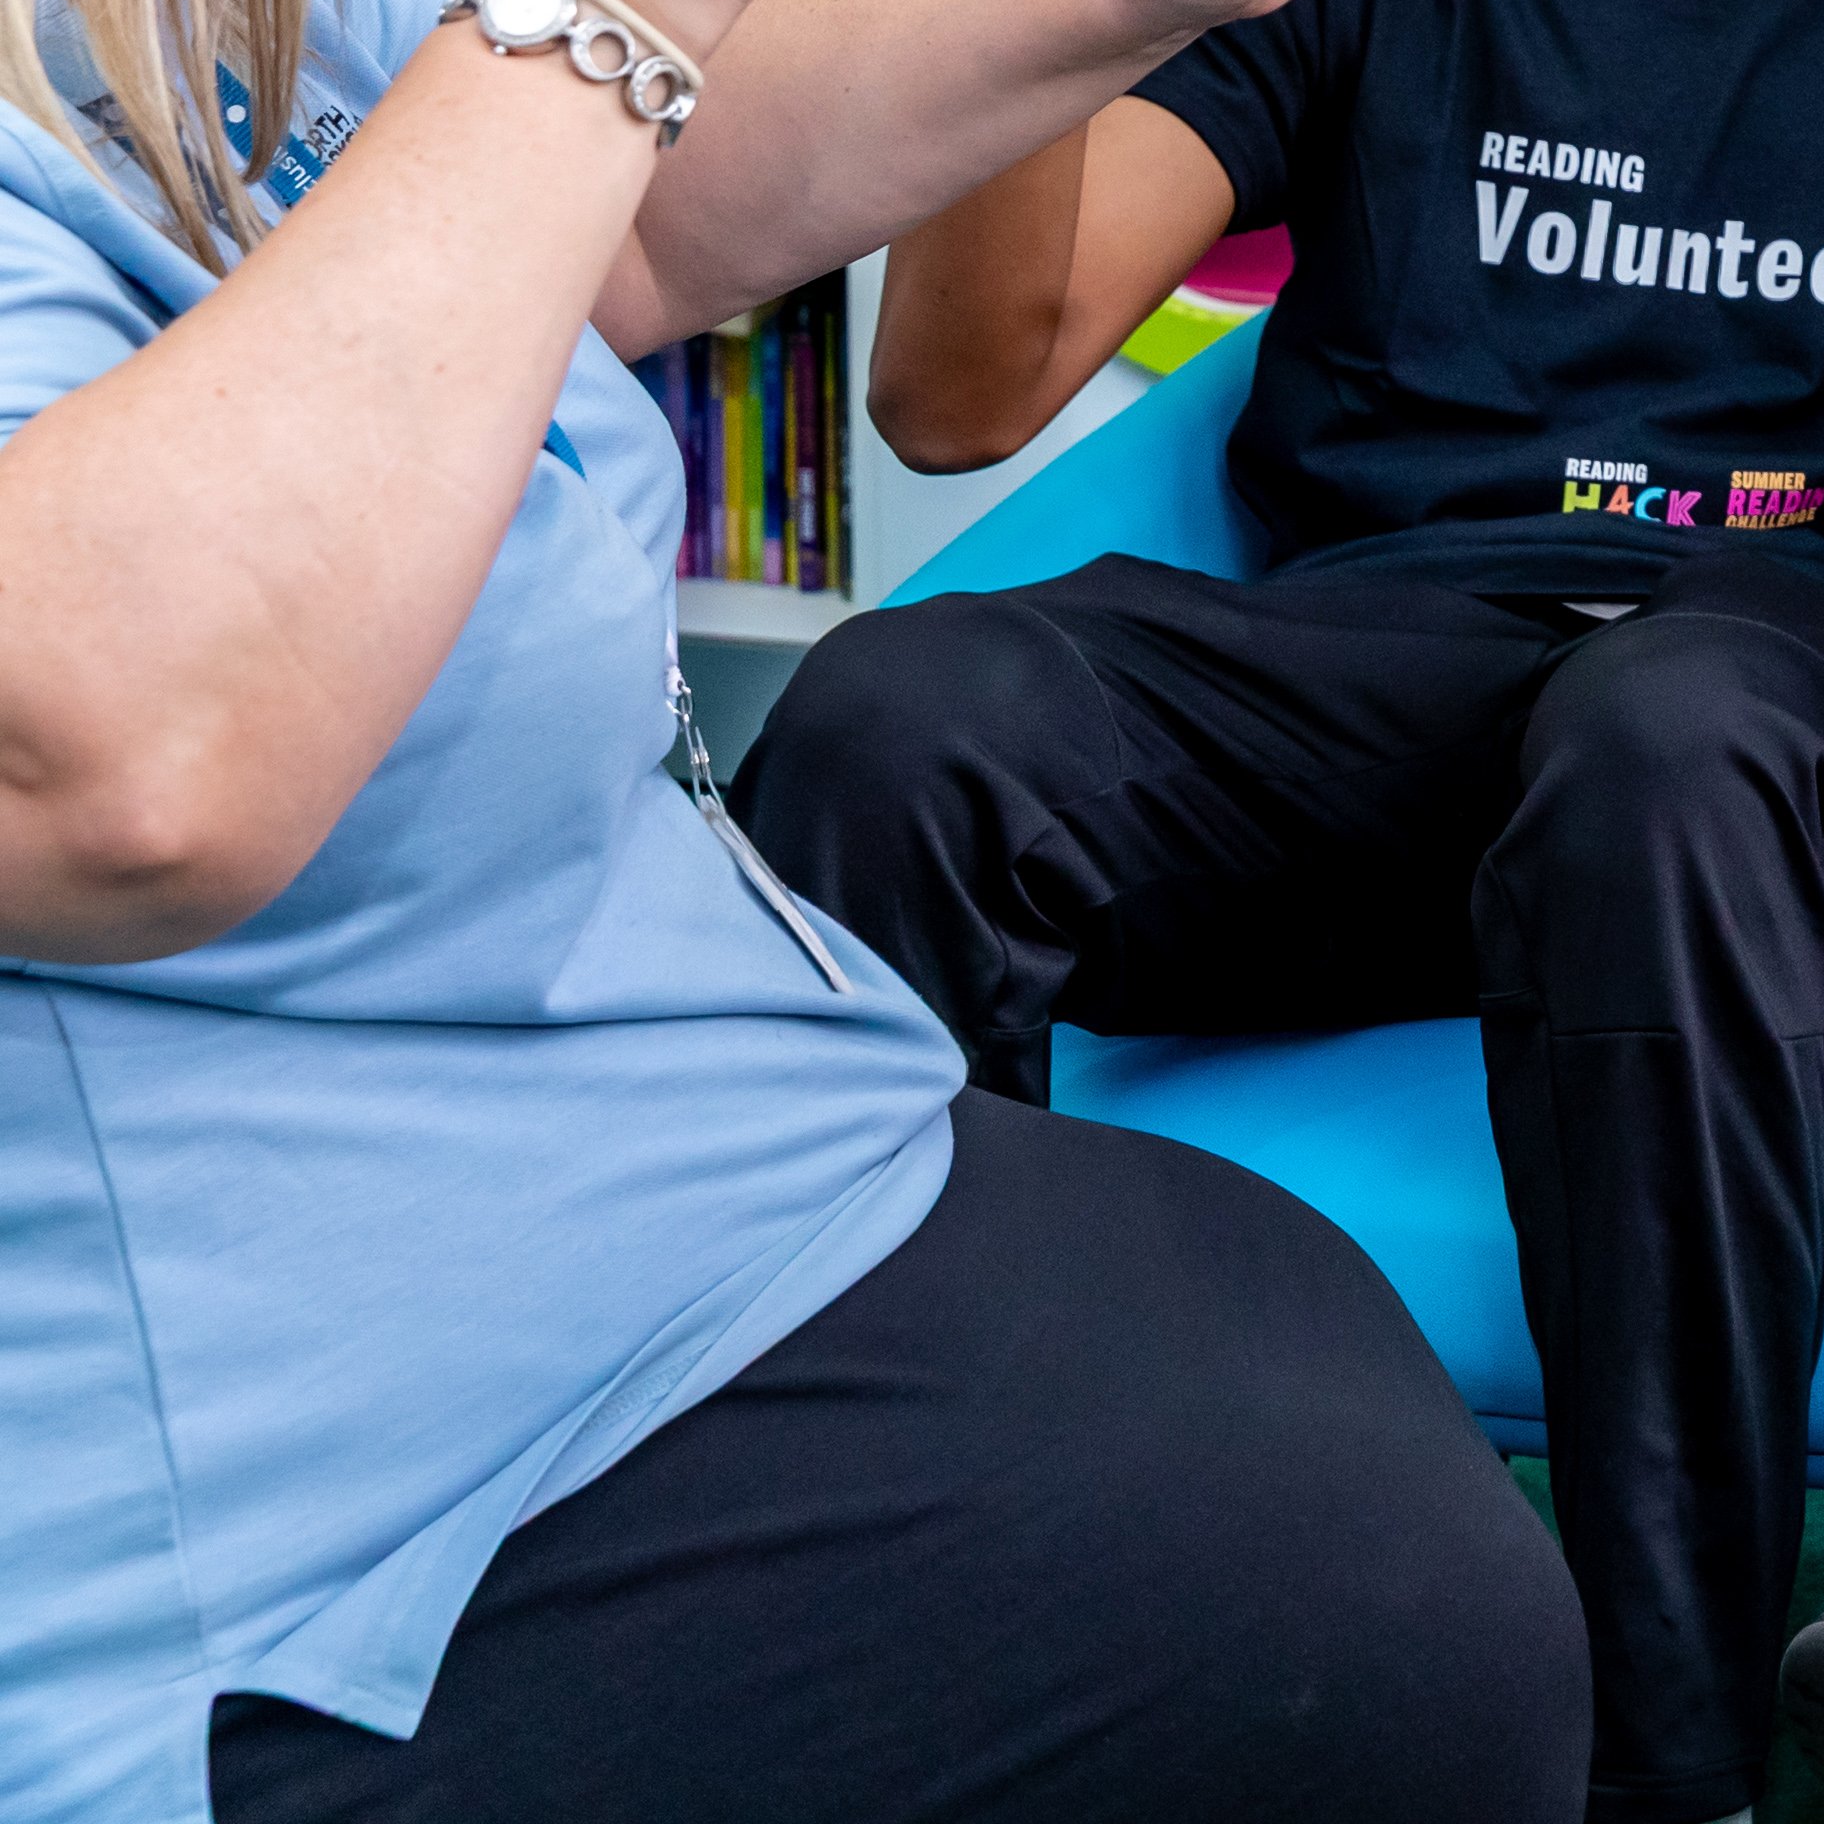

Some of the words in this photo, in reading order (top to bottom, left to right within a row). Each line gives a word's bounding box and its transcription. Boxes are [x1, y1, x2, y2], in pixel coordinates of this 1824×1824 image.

[1479, 131, 1646, 193] READING
[1565, 457, 1648, 484] READING
[1730, 470, 1806, 491] SUMMER
[1562, 480, 1702, 527] HACK
[1725, 506, 1817, 530] CHALLENGE
